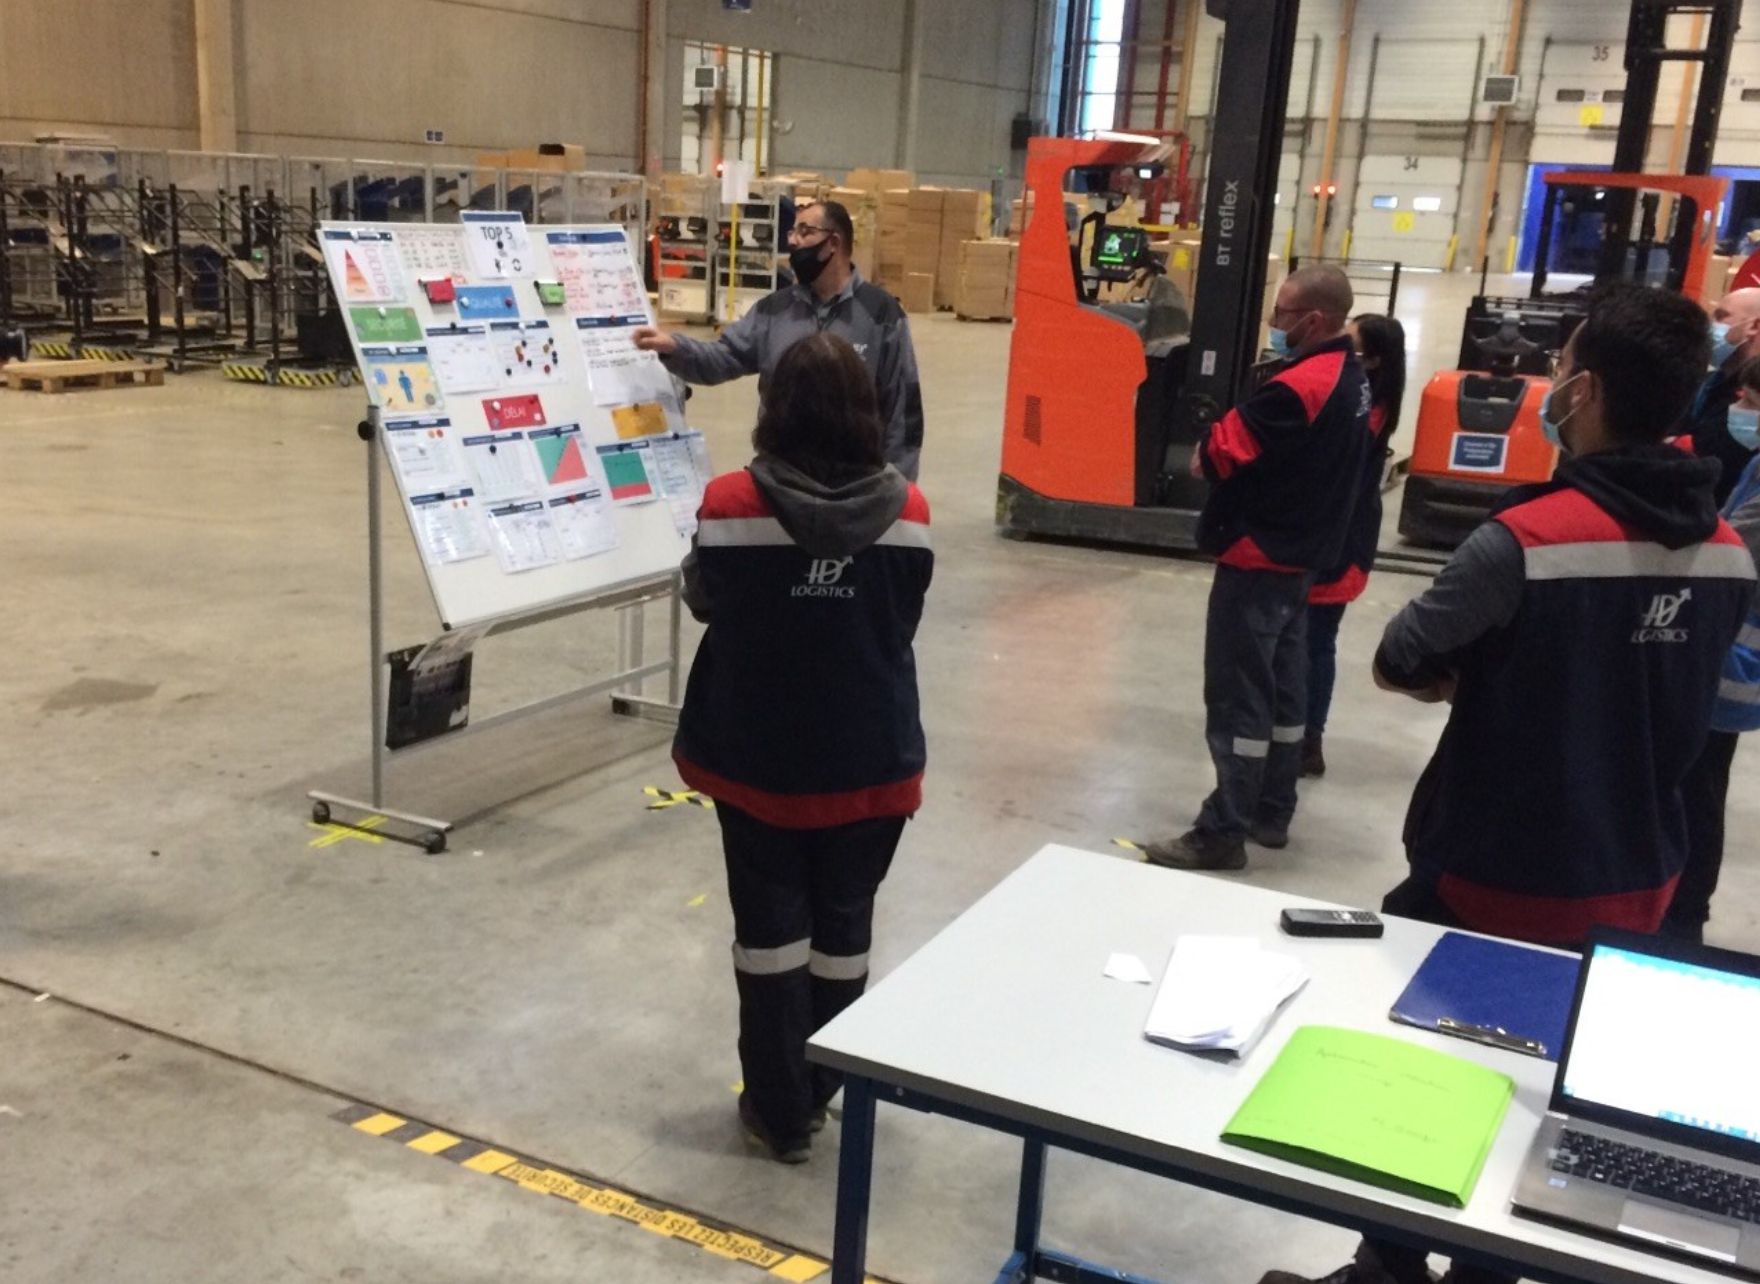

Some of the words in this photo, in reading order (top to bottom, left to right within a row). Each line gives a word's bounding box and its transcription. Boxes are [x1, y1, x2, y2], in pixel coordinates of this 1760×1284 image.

[1592, 45, 1610, 62] 35
[1403, 155, 1419, 171] 34
[1217, 179, 1239, 238] reflex
[480, 226, 503, 242] TOP
[504, 226, 513, 240] 5
[1216, 243, 1231, 267] BT
[790, 585, 856, 598] LOGISTICS
[1630, 628, 1690, 643] LOGISTICS
[591, 1194, 668, 1228] DISTANCES
[667, 1218, 694, 1238] LES
[694, 1227, 774, 1264] RESPECTEZ
